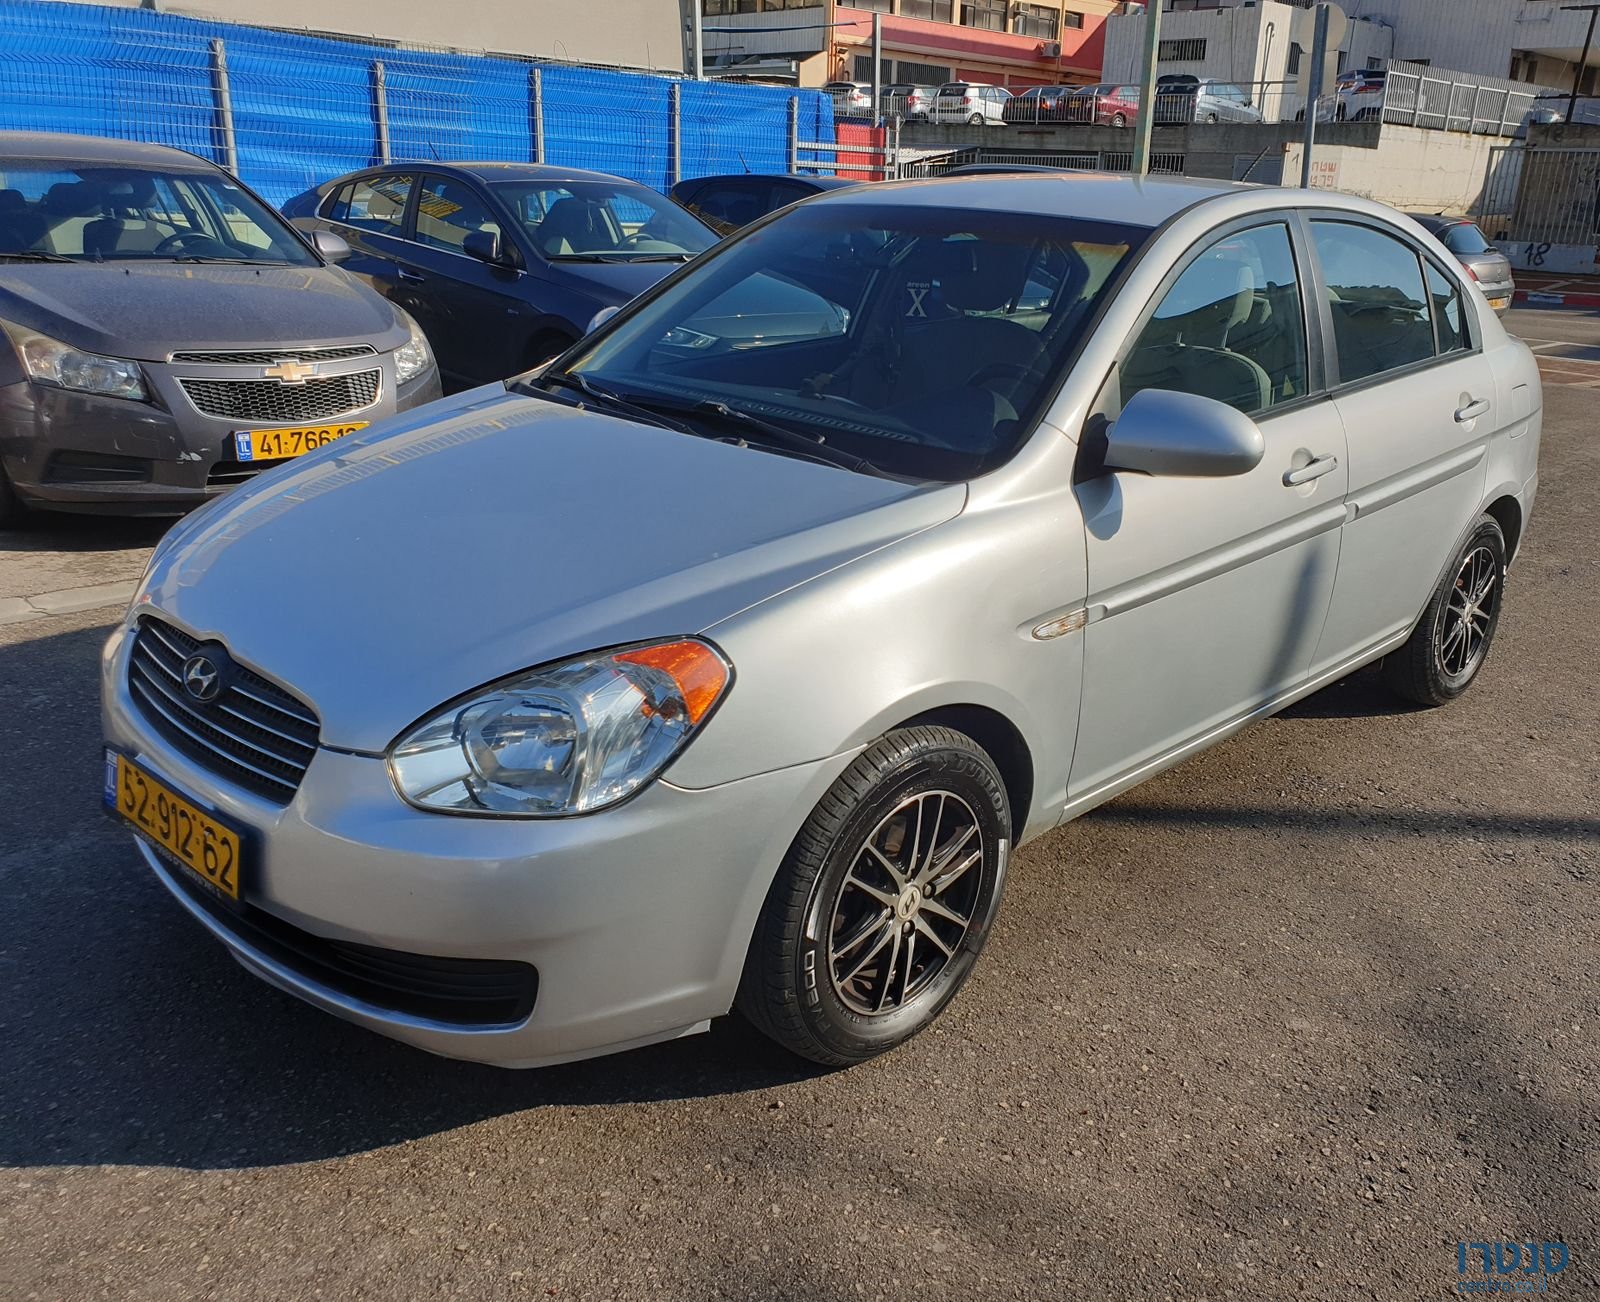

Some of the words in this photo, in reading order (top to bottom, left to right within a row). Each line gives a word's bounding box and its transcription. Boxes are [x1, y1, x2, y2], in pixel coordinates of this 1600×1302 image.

[1312, 160, 1337, 173] שטח
[1311, 174, 1334, 188] פרט
[1524, 242, 1551, 266] 18
[905, 288, 929, 318] X
[240, 441, 250, 453] IL
[949, 755, 1007, 825] DUNLOP
